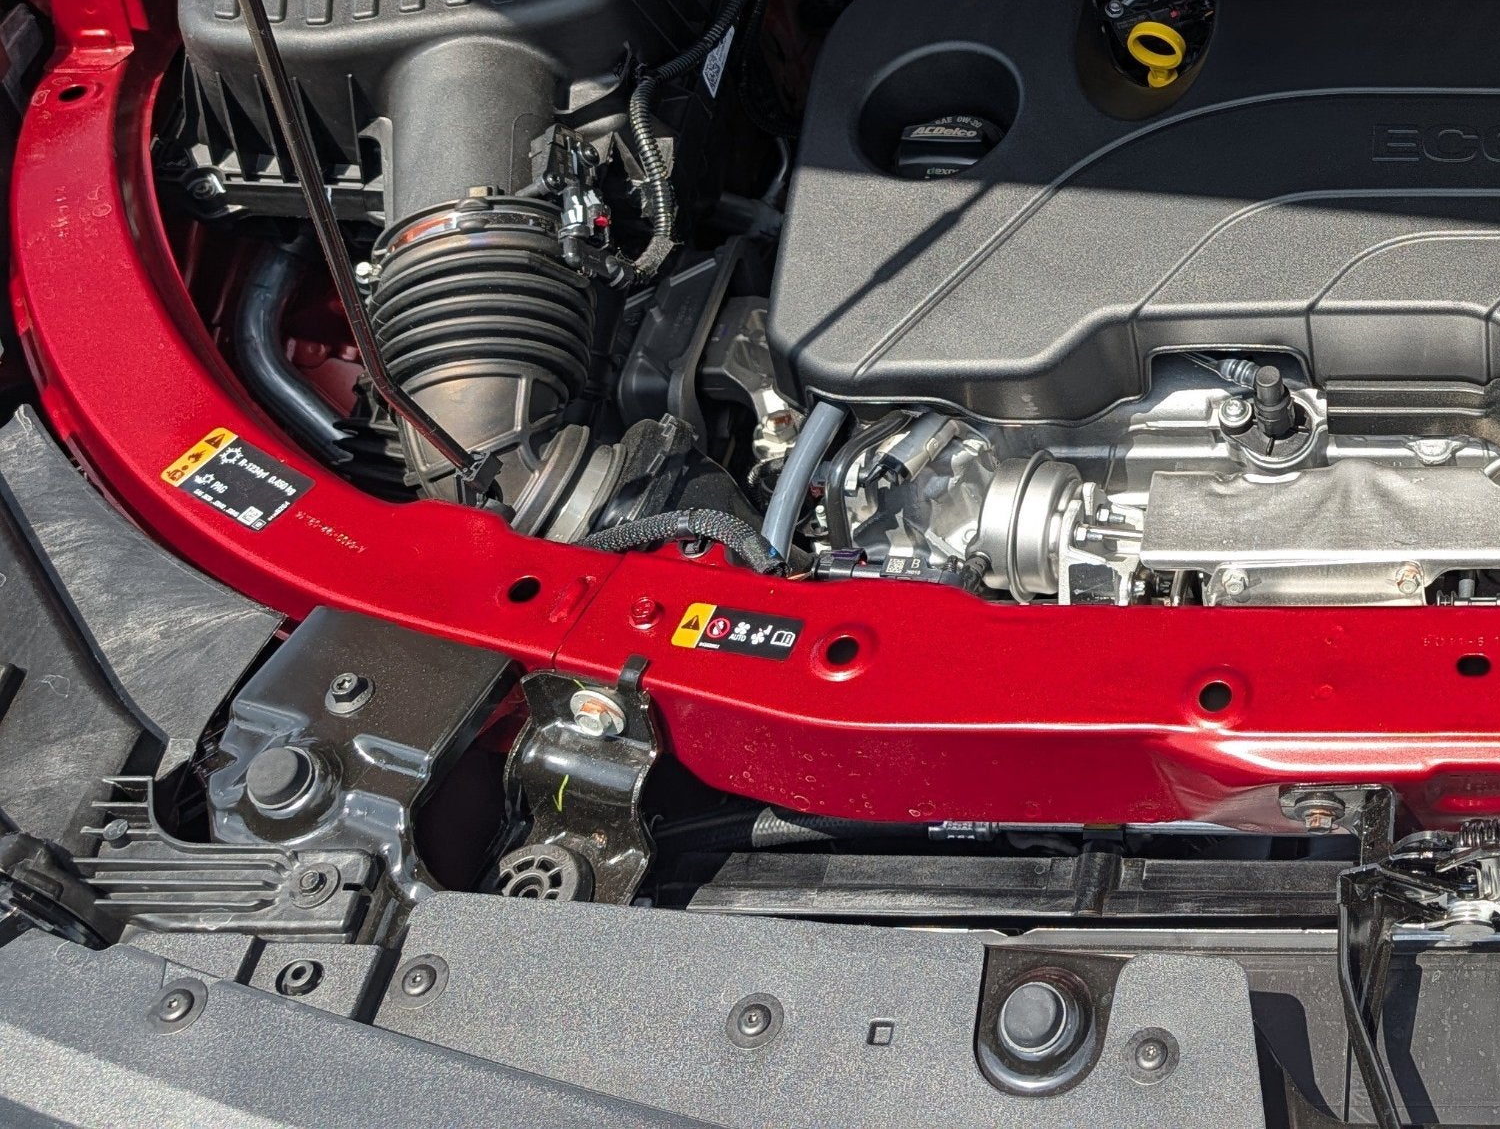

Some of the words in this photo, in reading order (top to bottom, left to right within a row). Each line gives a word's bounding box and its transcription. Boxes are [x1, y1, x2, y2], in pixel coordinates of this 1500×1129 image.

[910, 126, 978, 138] ACDelco
[210, 480, 229, 495] PAG
[910, 558, 921, 569] B
[728, 633, 747, 643] AUTO
